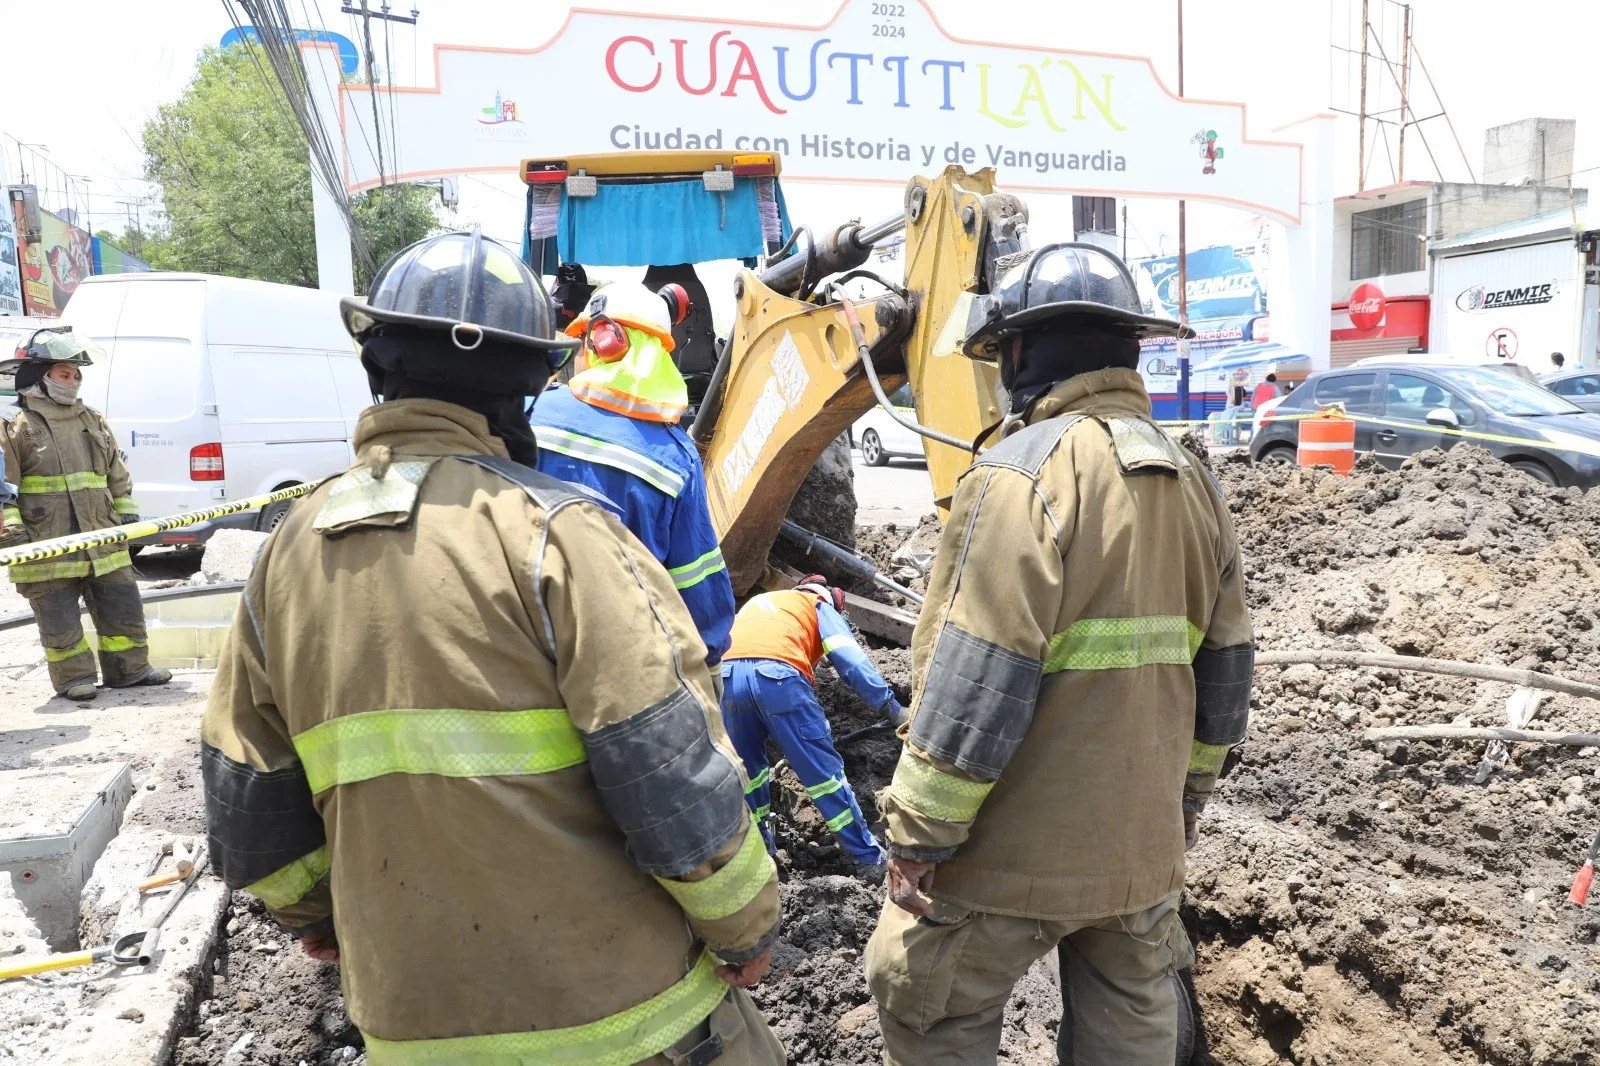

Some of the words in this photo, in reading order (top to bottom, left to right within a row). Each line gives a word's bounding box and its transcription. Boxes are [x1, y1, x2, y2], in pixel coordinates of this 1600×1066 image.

[872, 3, 905, 17] 2022
[872, 24, 906, 38] 2024
[605, 30, 1127, 132] CUAUTITLÁN
[609, 124, 722, 151] Ciudad
[735, 135, 789, 156] con
[801, 133, 911, 162] Historia
[921, 144, 935, 166] y
[943, 141, 976, 164] de
[985, 144, 1127, 173] Vanguardia
[1484, 283, 1551, 304] DENMIR
